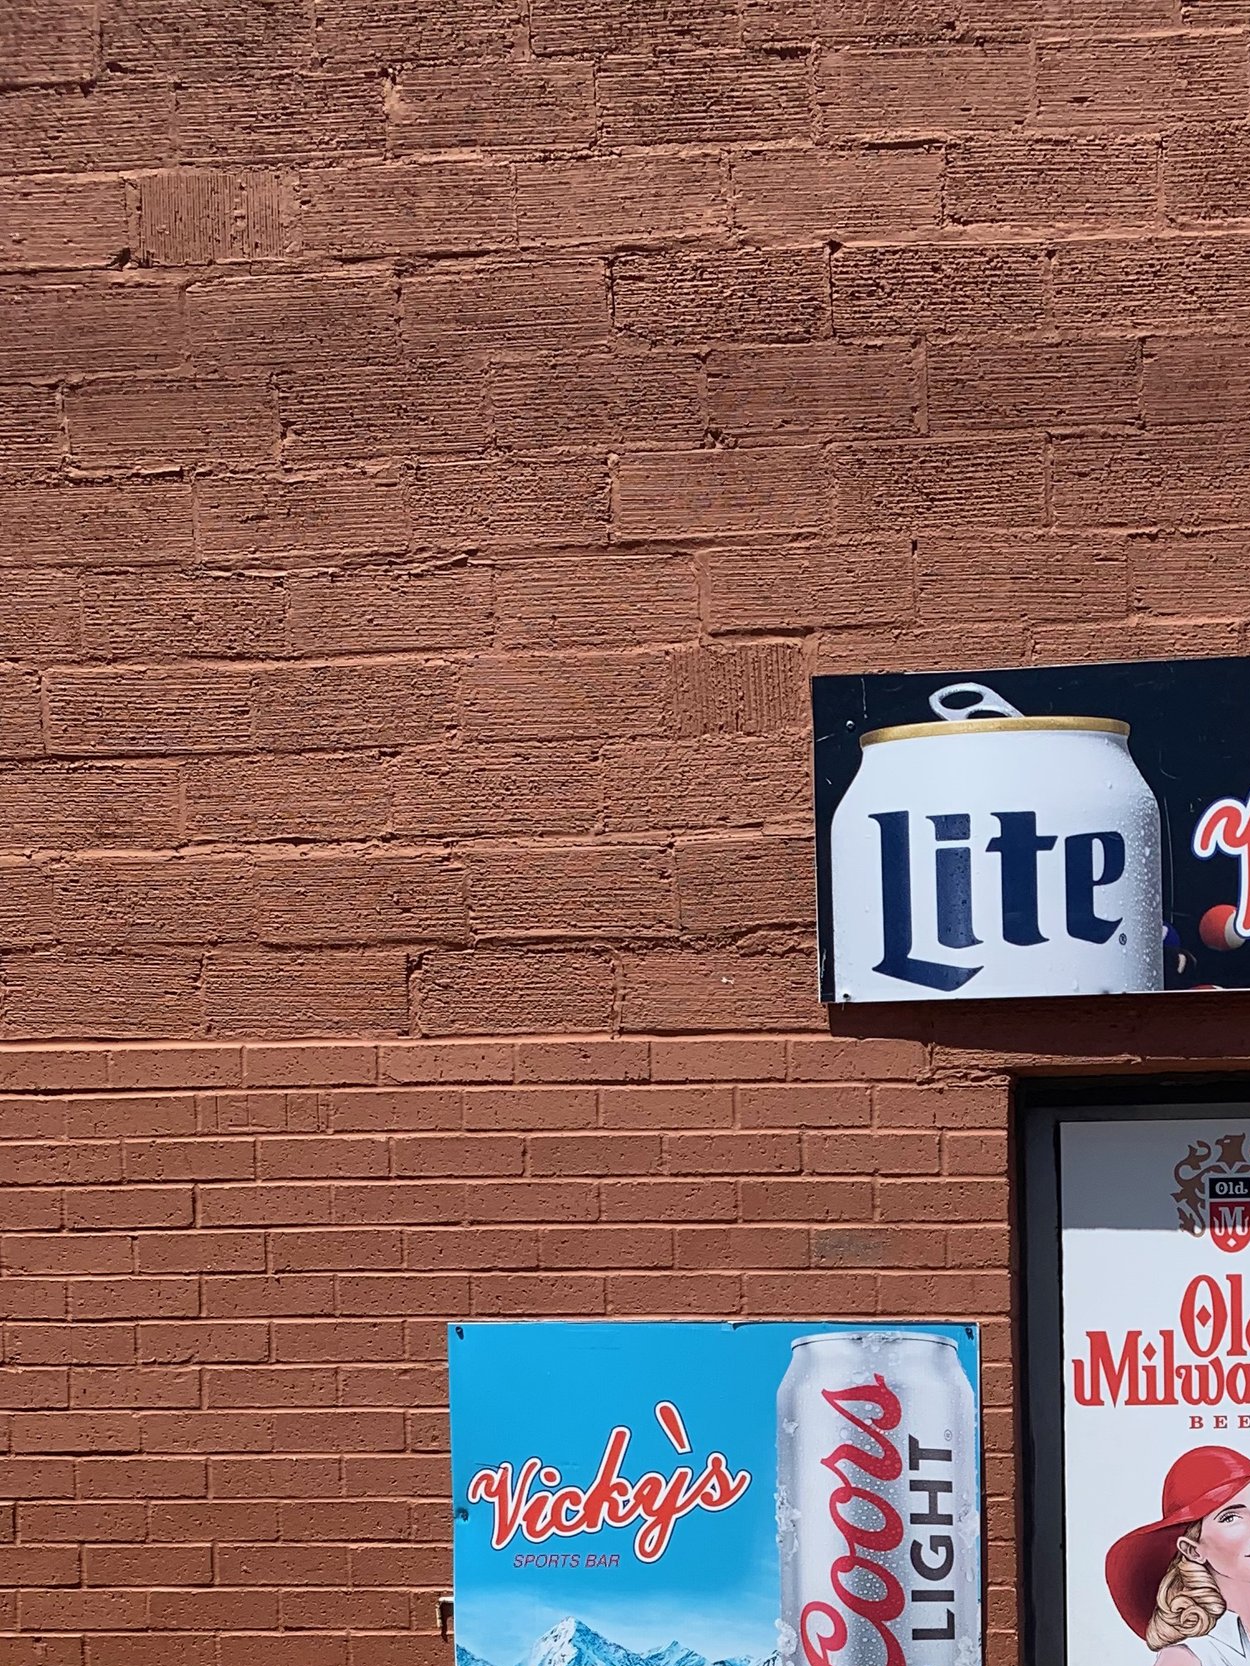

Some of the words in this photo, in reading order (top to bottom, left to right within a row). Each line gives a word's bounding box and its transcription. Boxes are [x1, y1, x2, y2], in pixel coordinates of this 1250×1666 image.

[868, 810, 1126, 992] Lite
[1212, 1206, 1250, 1236] M
[1215, 1181, 1248, 1195] Old
[467, 1401, 752, 1563] Vicky's
[513, 1553, 581, 1568] SPORTS
[584, 1553, 620, 1568] BAR
[908, 1435, 956, 1642] LIGHT
